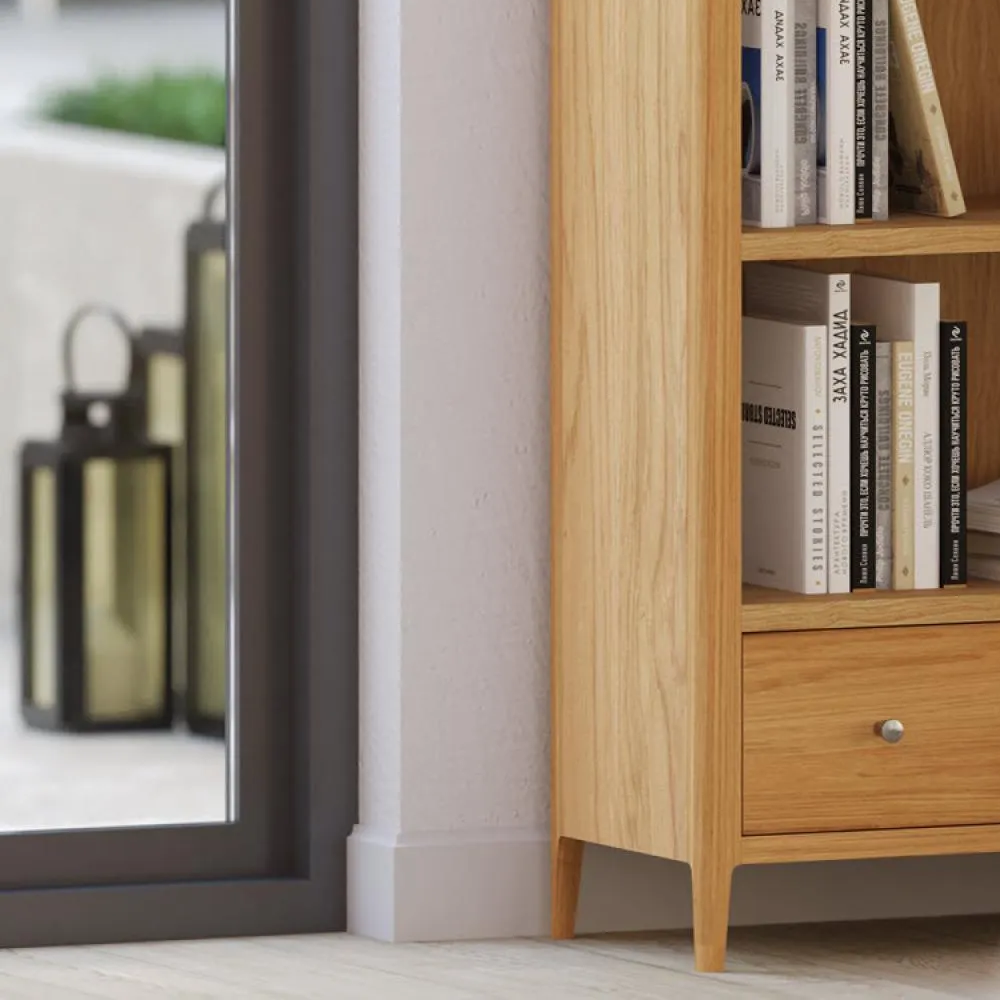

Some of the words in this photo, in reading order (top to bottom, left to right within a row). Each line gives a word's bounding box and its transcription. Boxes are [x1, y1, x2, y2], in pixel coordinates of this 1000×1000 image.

[833, 309, 848, 360] ХАДИД
[833, 367, 847, 403] ЗАХА
[898, 352, 914, 406] EUGENE
[812, 424, 823, 496] SELECTED
[898, 412, 914, 464] ONEGIN
[812, 508, 823, 570] STORIES
